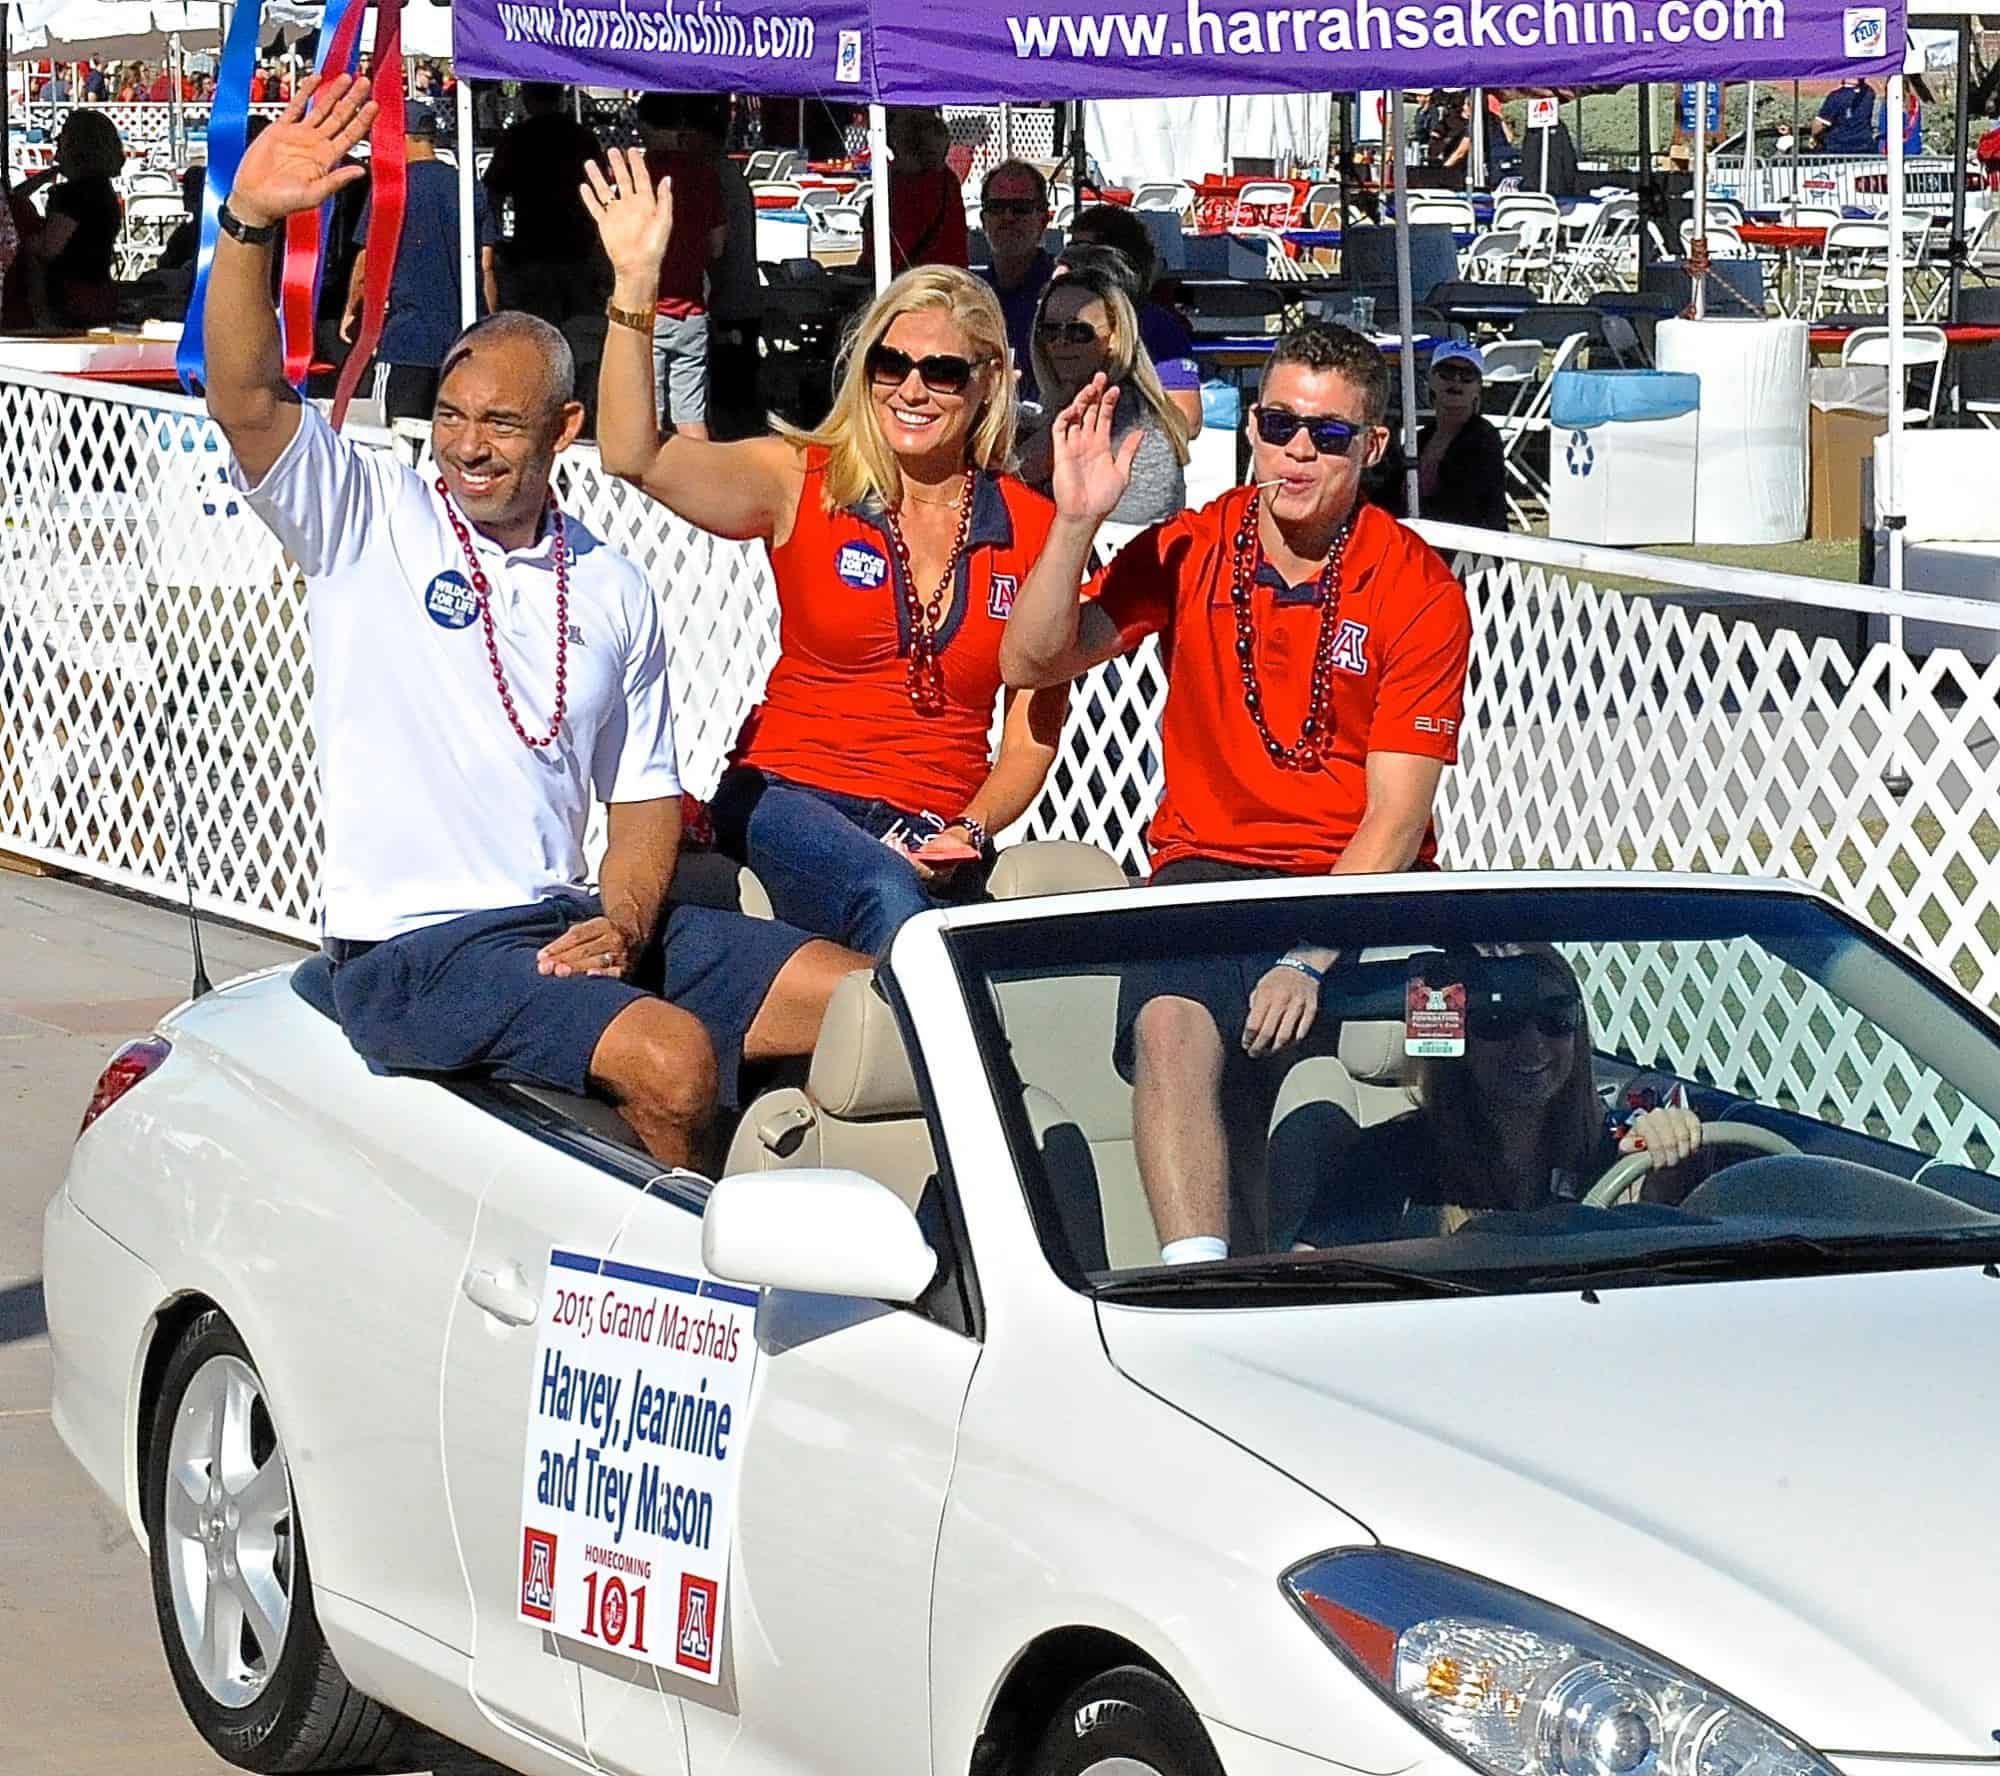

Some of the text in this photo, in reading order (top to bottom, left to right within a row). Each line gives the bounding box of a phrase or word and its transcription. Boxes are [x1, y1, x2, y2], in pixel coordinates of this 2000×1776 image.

[497, 0, 815, 58] www.harrahsakchin.com
[1006, 0, 1785, 58] www.harrahsakchin.com
[840, 557, 863, 573] FOR
[430, 590, 454, 611] FOR
[455, 597, 477, 616] LIFE
[1331, 621, 1368, 675] A
[552, 1289, 740, 1363] 2015 Grand Marshals
[539, 1347, 732, 1461] Harvey, Jeannine
[537, 1439, 713, 1551] and Trey Mason
[584, 1544, 652, 1580] HOMECOMING
[525, 1540, 708, 1658] A 101 A
